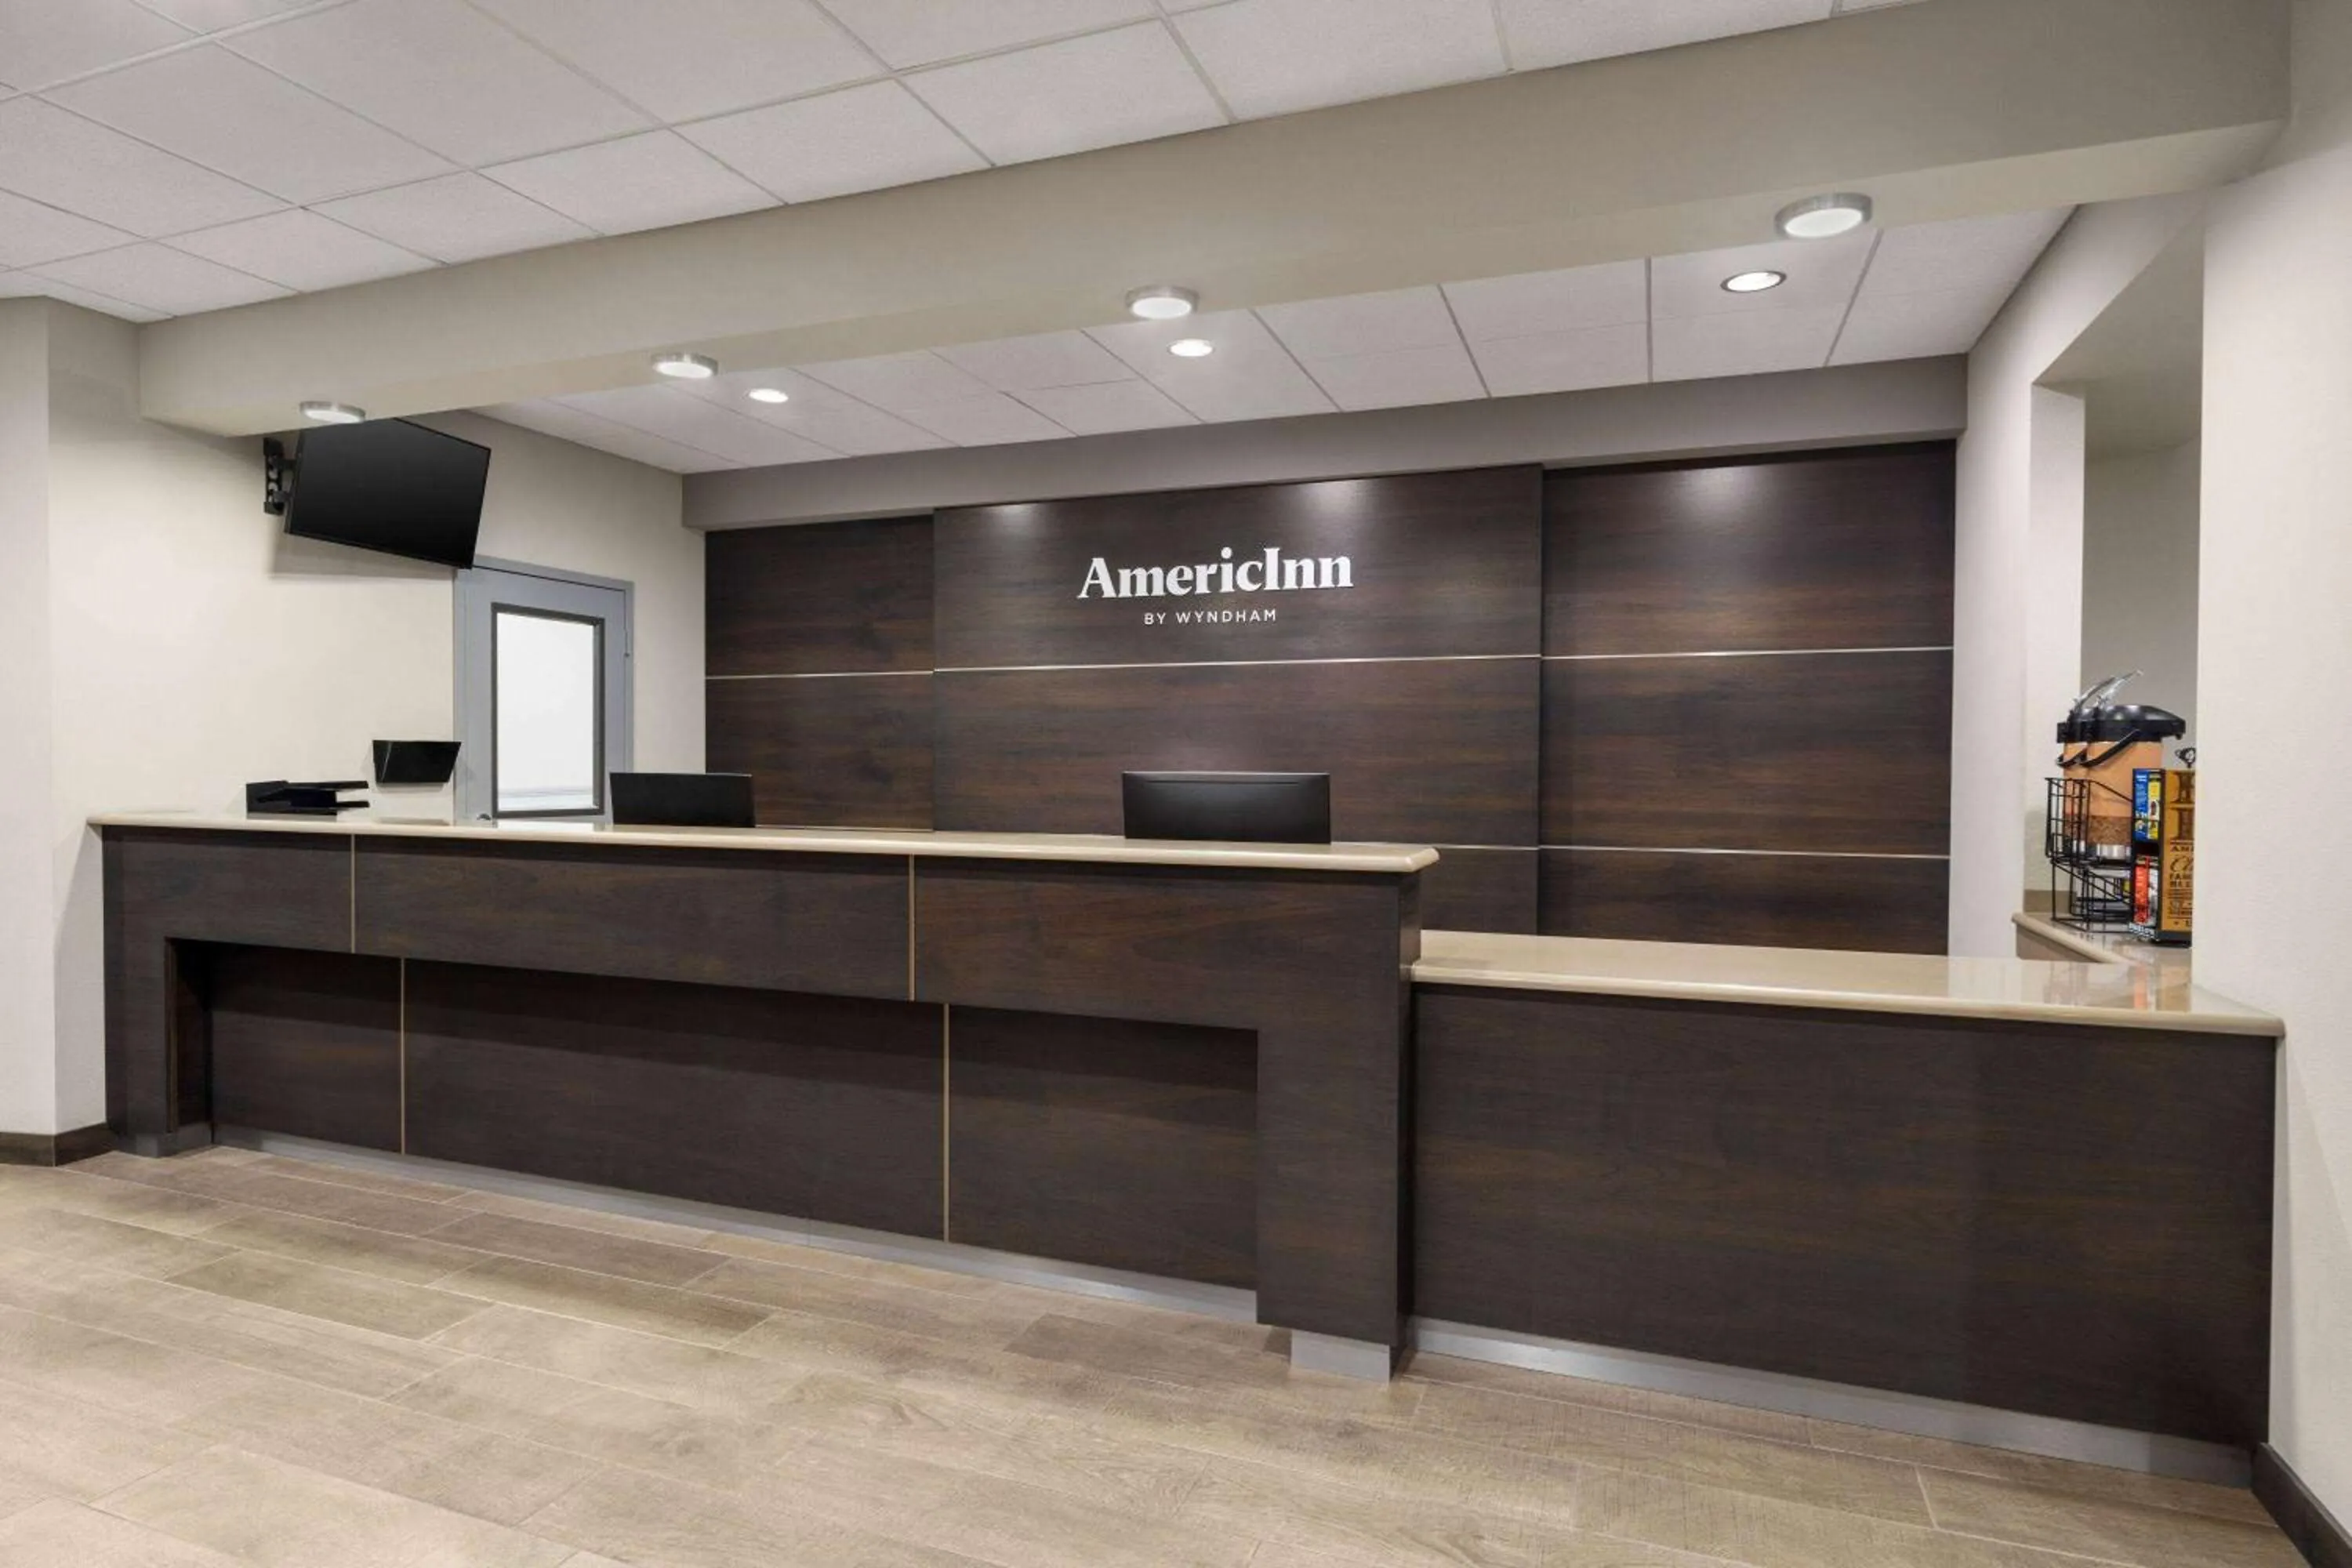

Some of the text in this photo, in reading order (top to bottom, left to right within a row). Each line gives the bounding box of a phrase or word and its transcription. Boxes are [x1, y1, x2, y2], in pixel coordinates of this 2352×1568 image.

[1076, 546, 1354, 599] AmericInn
[1143, 608, 1277, 626] BY WYNDHAM
